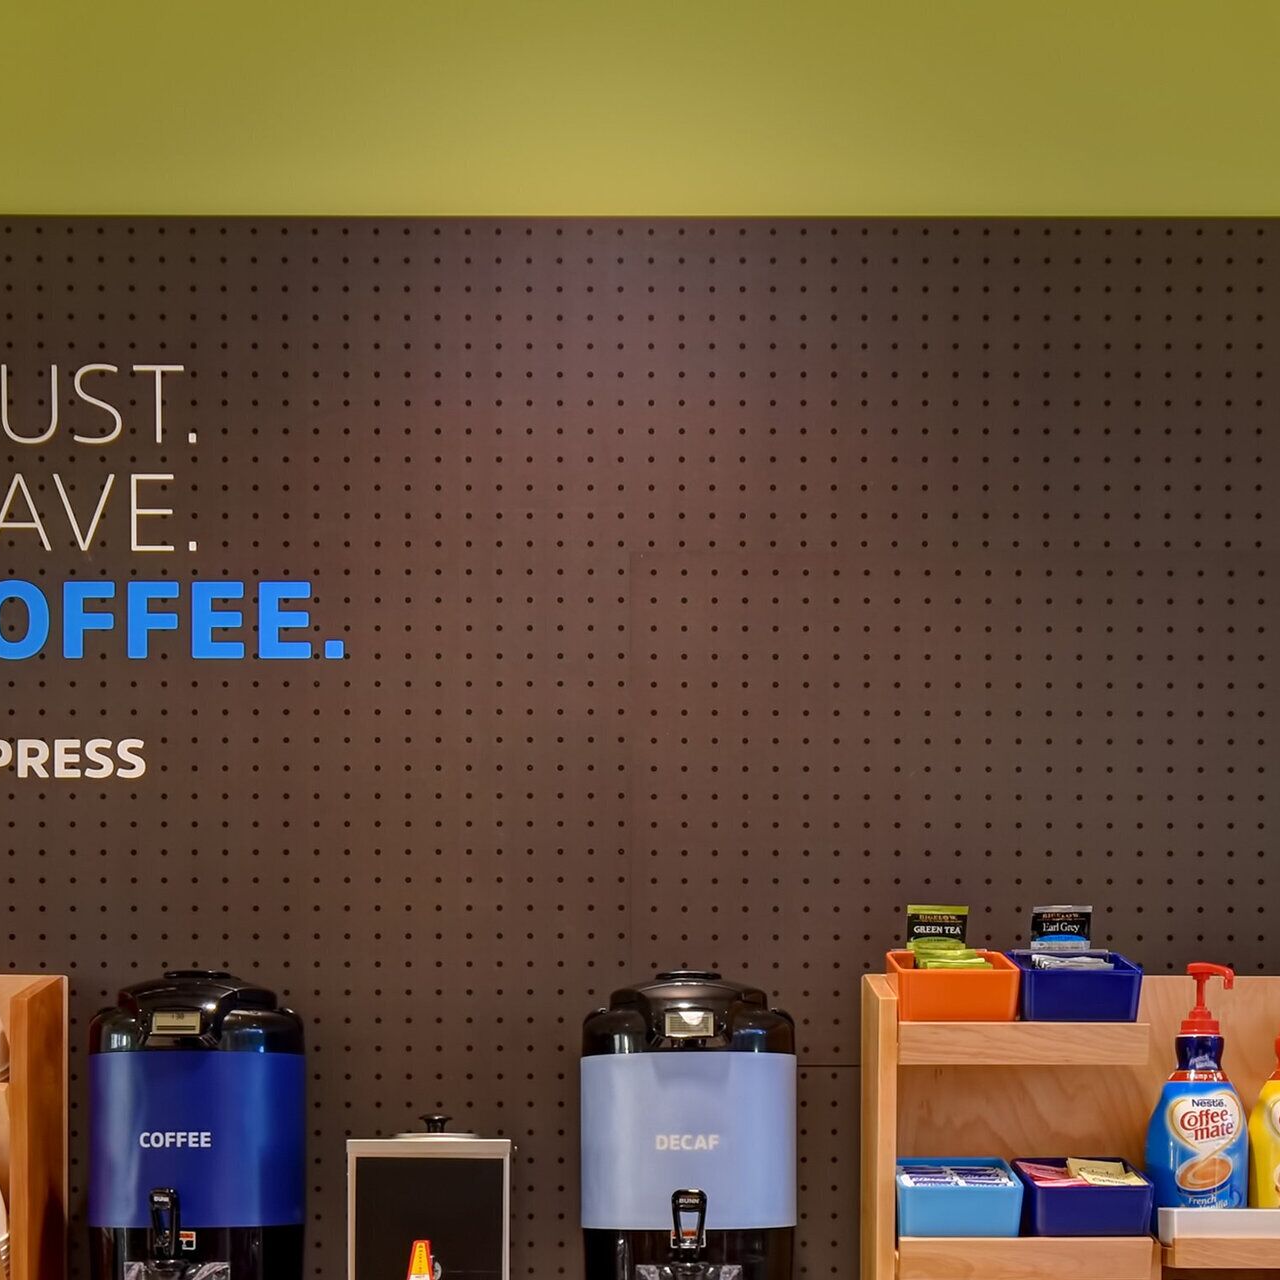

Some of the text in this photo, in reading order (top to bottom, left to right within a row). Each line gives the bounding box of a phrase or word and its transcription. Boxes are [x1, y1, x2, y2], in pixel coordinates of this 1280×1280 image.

[913, 925, 962, 934] GREEN TEA
[1042, 922, 1080, 933] Earl Grey
[1194, 1122, 1233, 1140] mate
[139, 1132, 211, 1148] COFFEE
[655, 1135, 720, 1150] DECAF
[1188, 1194, 1217, 1205] French
